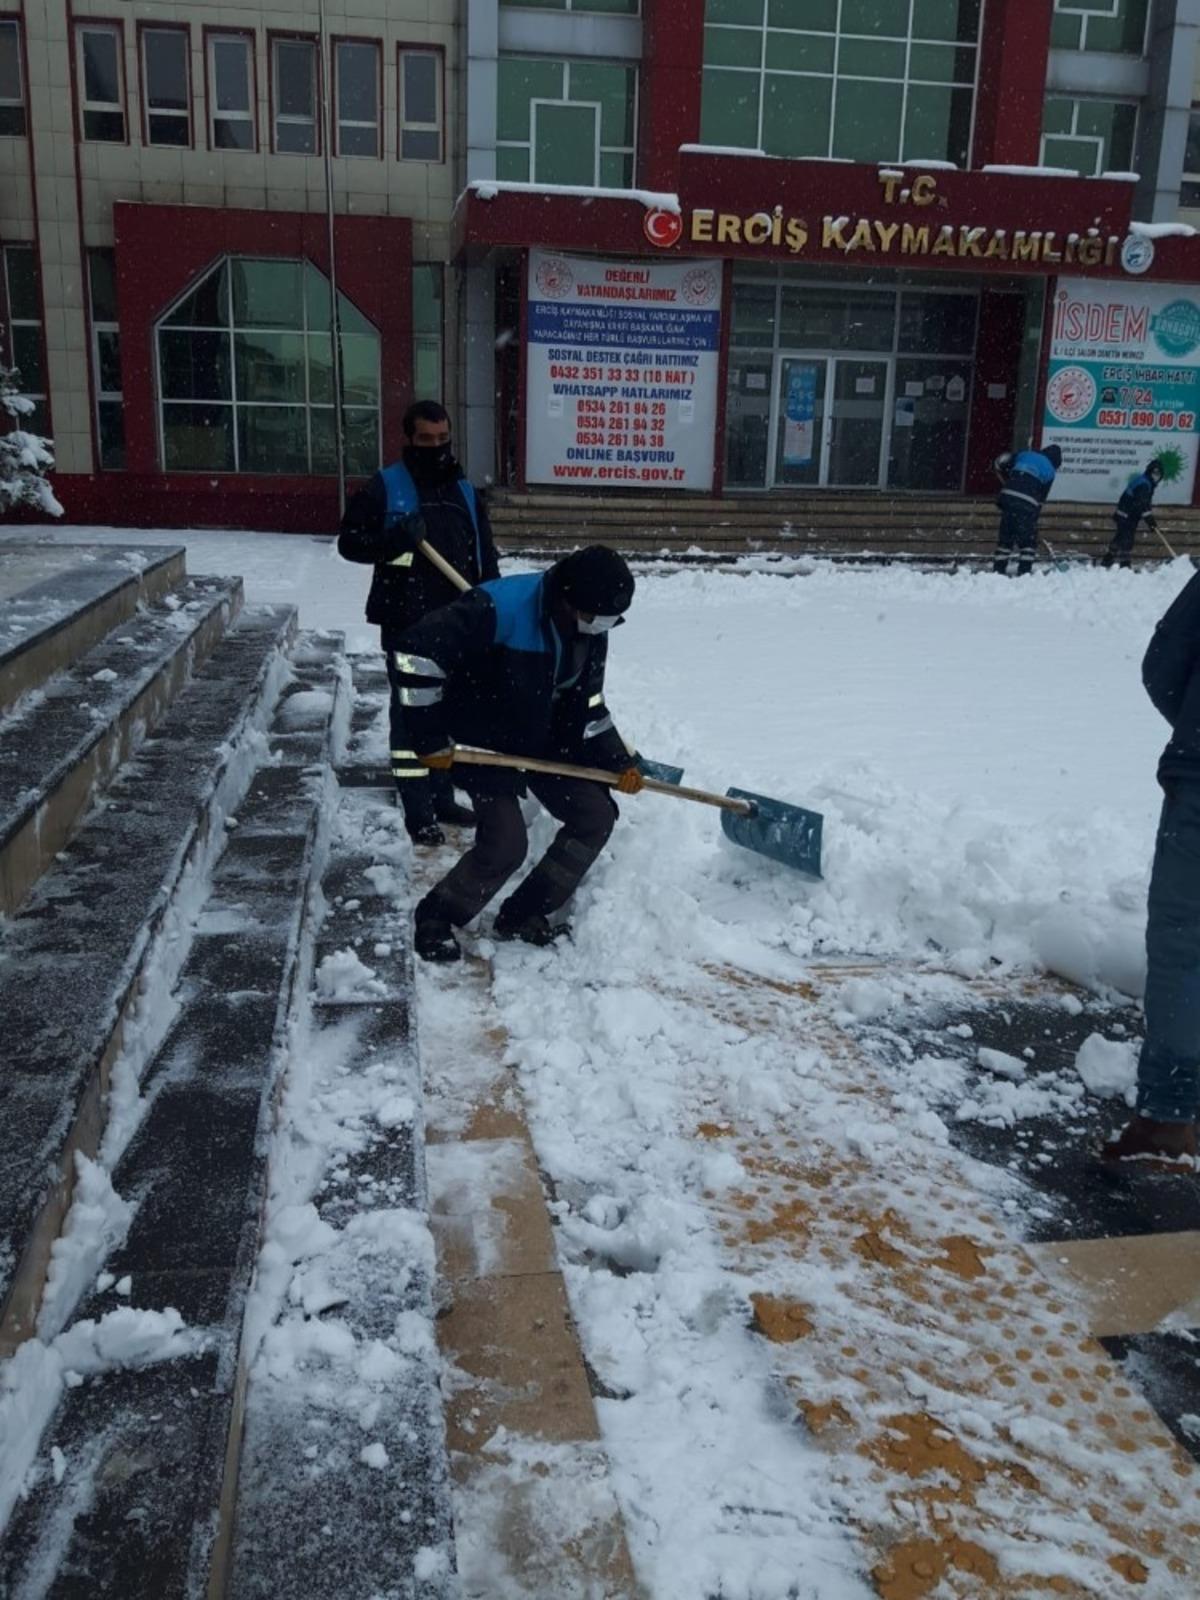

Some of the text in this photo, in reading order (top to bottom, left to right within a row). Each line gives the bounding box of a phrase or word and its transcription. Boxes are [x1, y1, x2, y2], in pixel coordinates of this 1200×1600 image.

[878, 169, 947, 206] T.C.
[691, 205, 1119, 266] ERCİŞ KAYMAKAMLIĞI
[605, 267, 650, 284] DEĞERLİ
[577, 284, 677, 301] VATANDAŞLARIMIZ
[1055, 290, 1150, 343] İSDEM
[583, 332, 599, 342] HER
[548, 348, 699, 367] SOSYAL DESTEK ÇAĞRI HATTIMIZ
[550, 365, 579, 379] 0432
[582, 367, 603, 380] 351
[608, 368, 622, 381] 33
[625, 369, 639, 382] 33
[665, 371, 687, 383] HAT
[1103, 365, 1132, 383] ERCİŞ
[553, 383, 692, 400] WHATSAPP HATLARIMIZ
[1120, 387, 1152, 406] 7/24
[577, 399, 606, 413] 0534
[577, 415, 605, 429] 0534
[651, 418, 665, 431] 32
[1098, 409, 1128, 426] 0531
[1131, 411, 1155, 427] 890
[576, 431, 604, 445] 0534
[566, 447, 675, 464] ONLINE BAŞVURU
[553, 465, 685, 481] www.ercis.gov.tr
